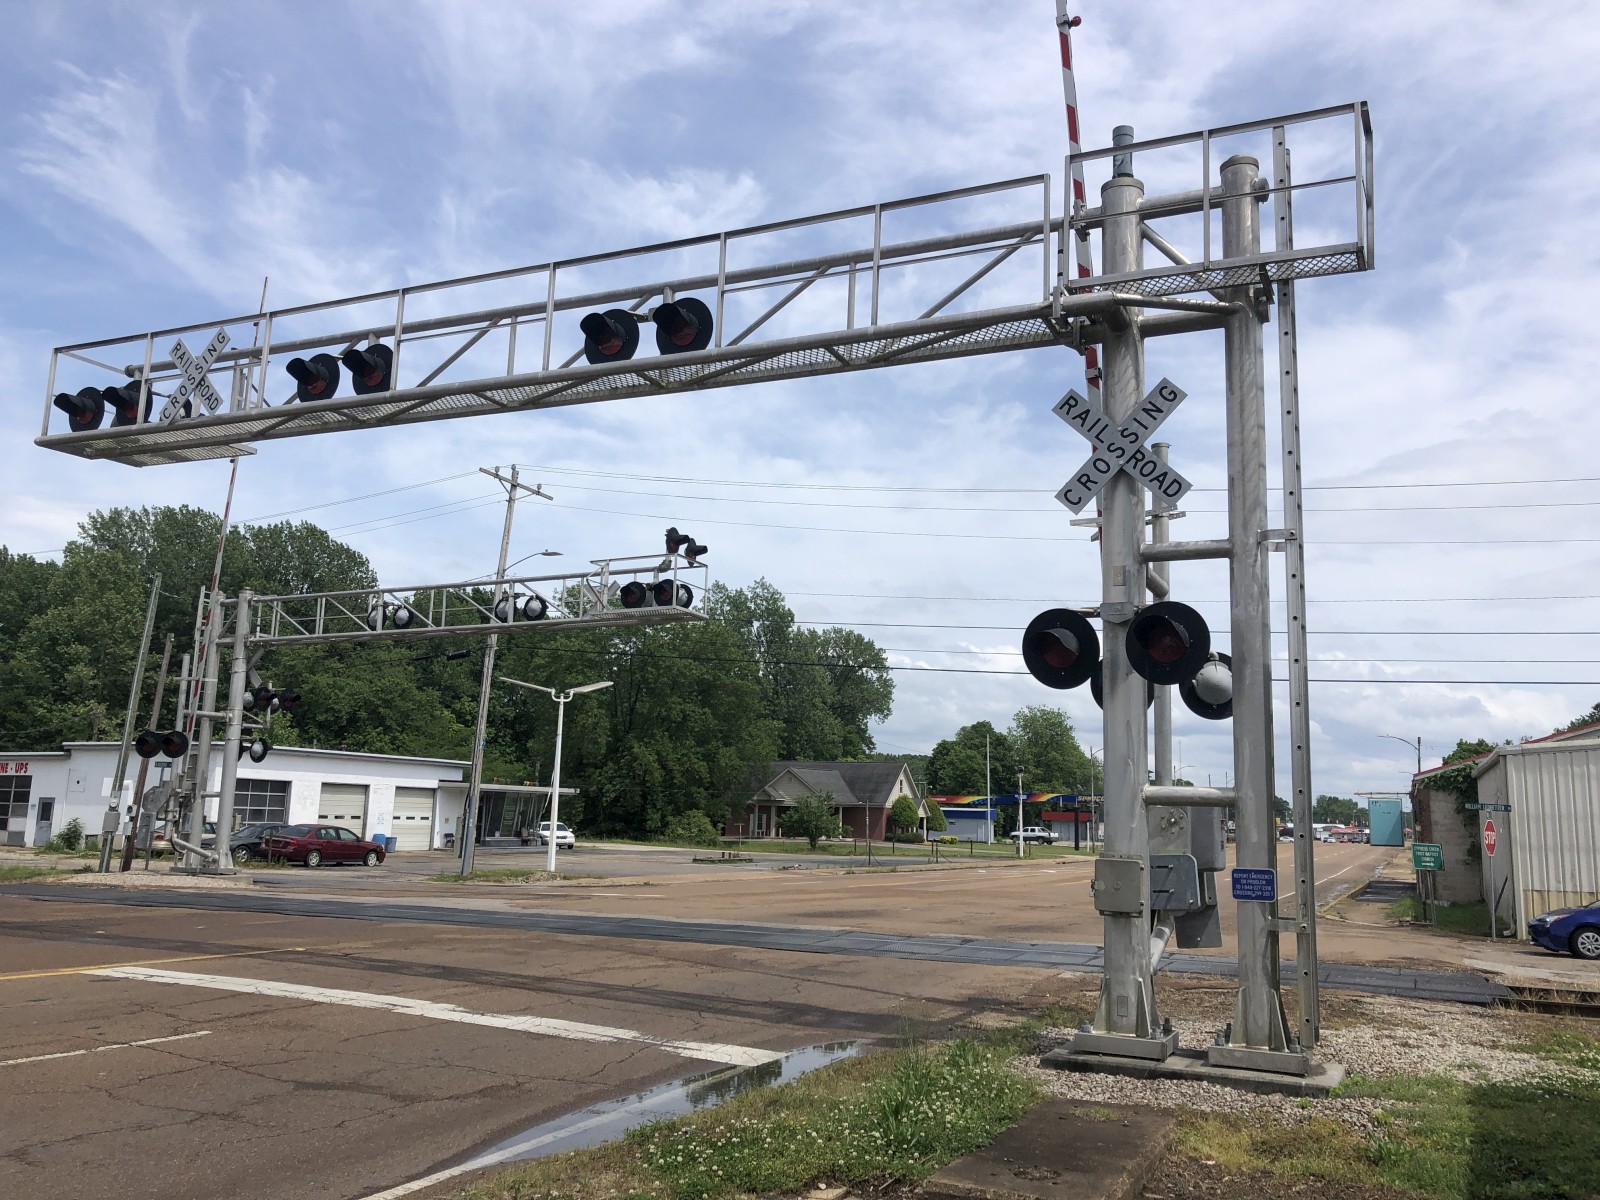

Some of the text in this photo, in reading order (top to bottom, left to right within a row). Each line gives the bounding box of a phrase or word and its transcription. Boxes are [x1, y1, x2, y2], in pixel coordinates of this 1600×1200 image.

[162, 332, 226, 420] CROSSING
[171, 342, 219, 411] RAIL ROAD
[1058, 395, 1183, 498] RAIL ROAD
[1063, 385, 1178, 506] CROSSING
[15, 763, 28, 773] UPS
[1485, 831, 1496, 845] STOP
